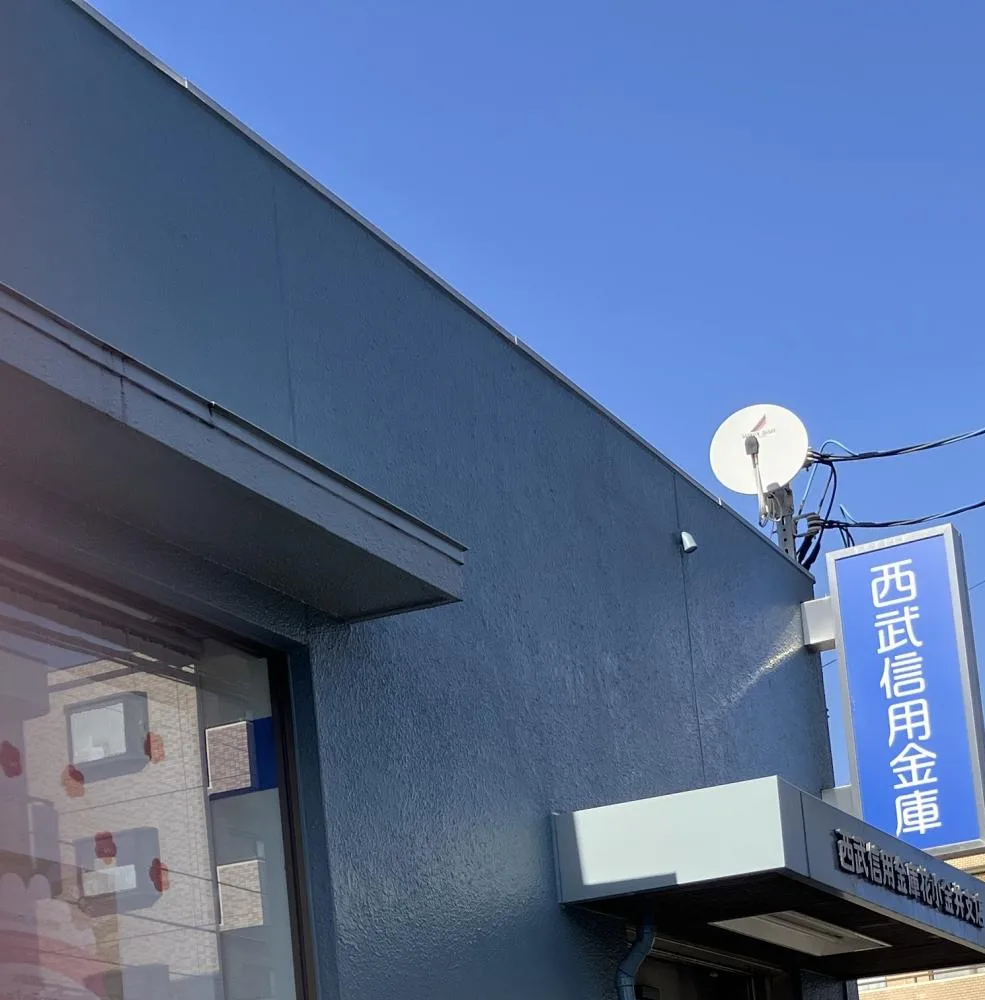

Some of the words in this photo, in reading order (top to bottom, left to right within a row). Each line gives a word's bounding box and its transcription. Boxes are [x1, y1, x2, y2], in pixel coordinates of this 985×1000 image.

[870, 558, 942, 836] 西武信用金庫
[835, 830, 985, 928] 西武信用金庫花小金井支店
